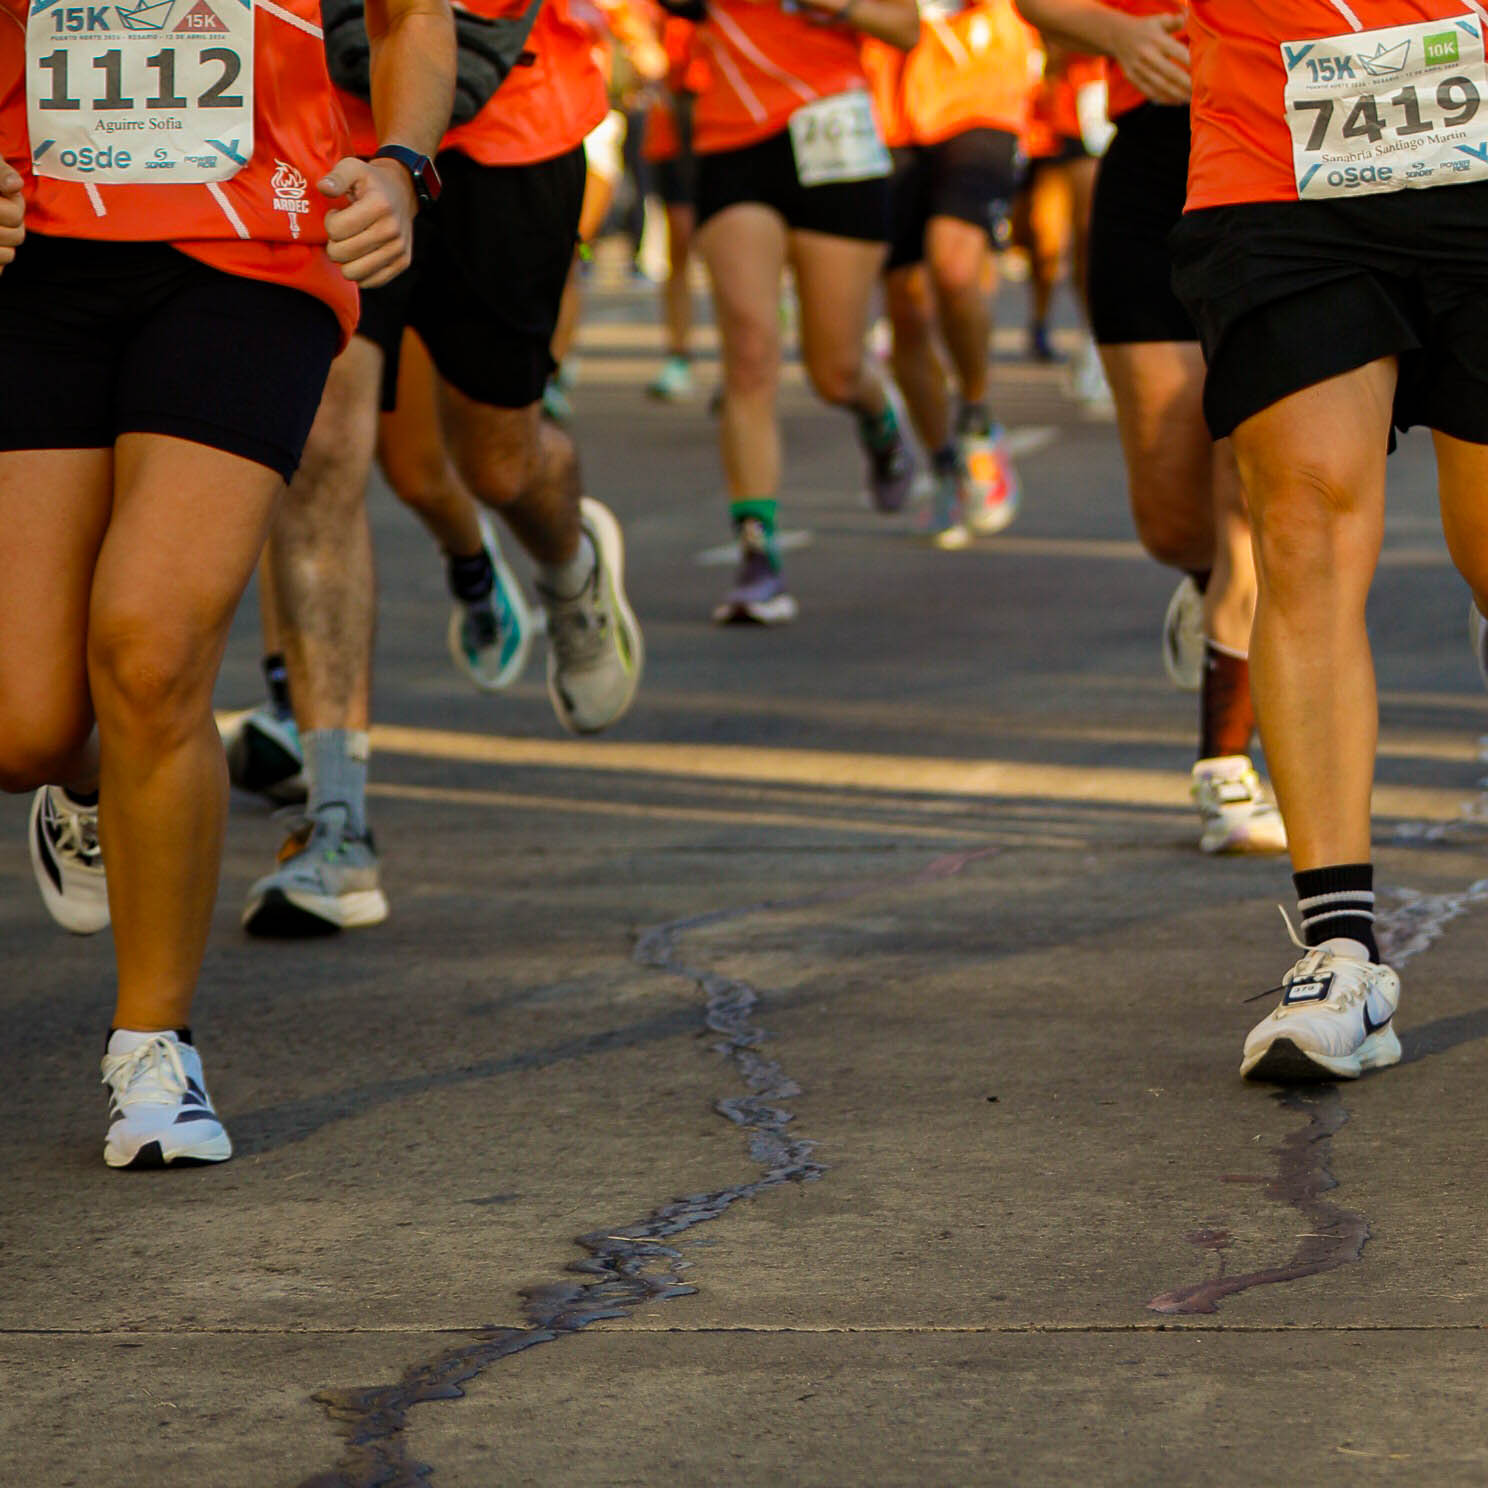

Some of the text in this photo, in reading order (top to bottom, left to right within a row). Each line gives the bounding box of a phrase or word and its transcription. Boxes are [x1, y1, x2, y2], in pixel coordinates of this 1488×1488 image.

[51, 6, 111, 32] 15K
[187, 14, 216, 28] 15K
[1428, 40, 1456, 57] 10K
[39, 47, 243, 110] 1112
[1306, 55, 1356, 82] 15K
[95, 118, 144, 133] Aguirre
[1293, 75, 1480, 151] 7419
[1321, 150, 1373, 163] Sanabria
[1375, 139, 1425, 156] Santiago
